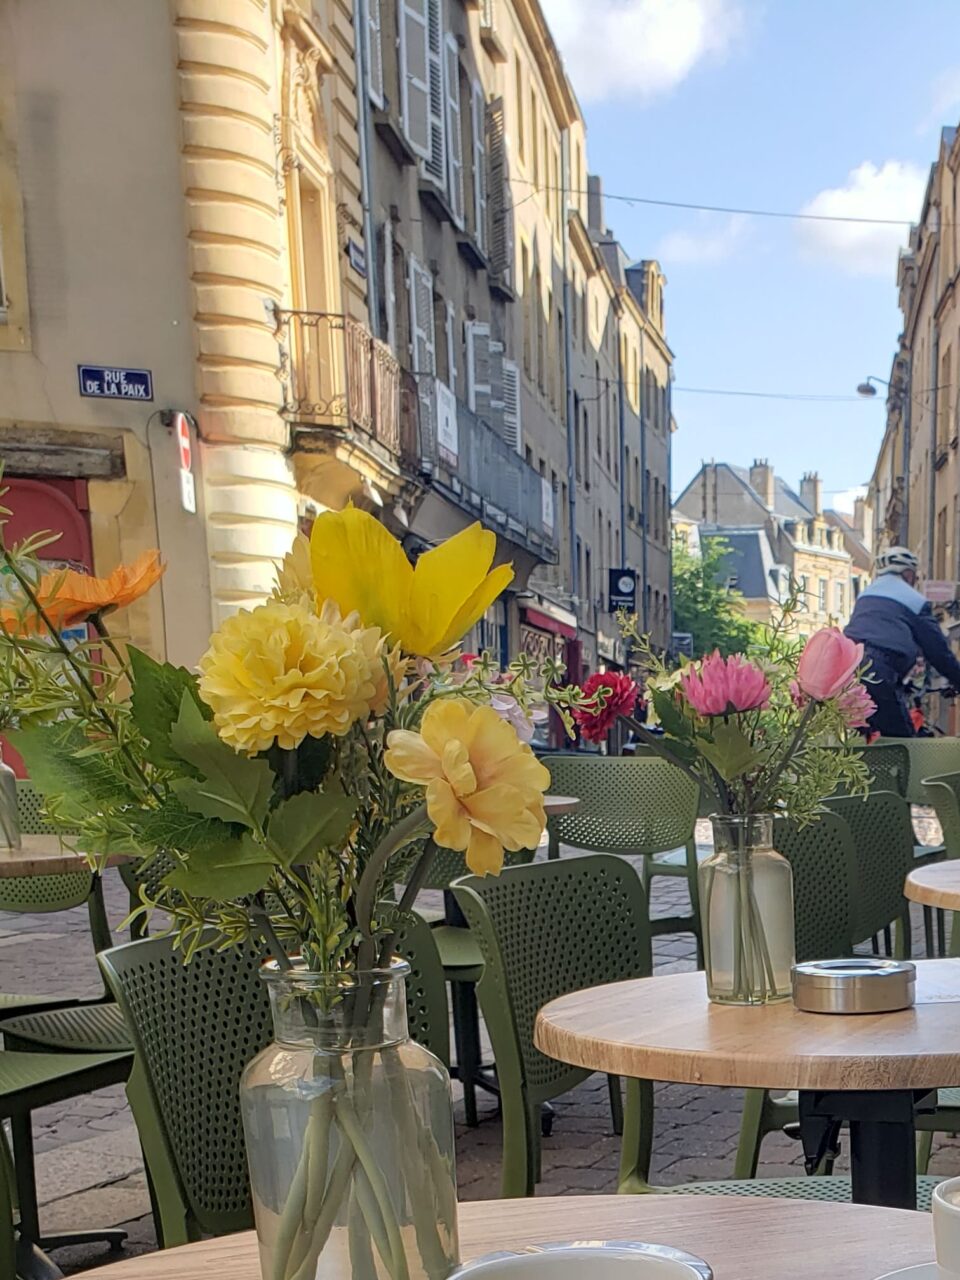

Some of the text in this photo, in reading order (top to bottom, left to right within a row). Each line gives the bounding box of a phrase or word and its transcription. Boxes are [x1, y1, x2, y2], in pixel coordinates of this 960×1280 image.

[104, 370, 127, 384] RUE
[86, 381, 145, 397] DE LA PAIX
